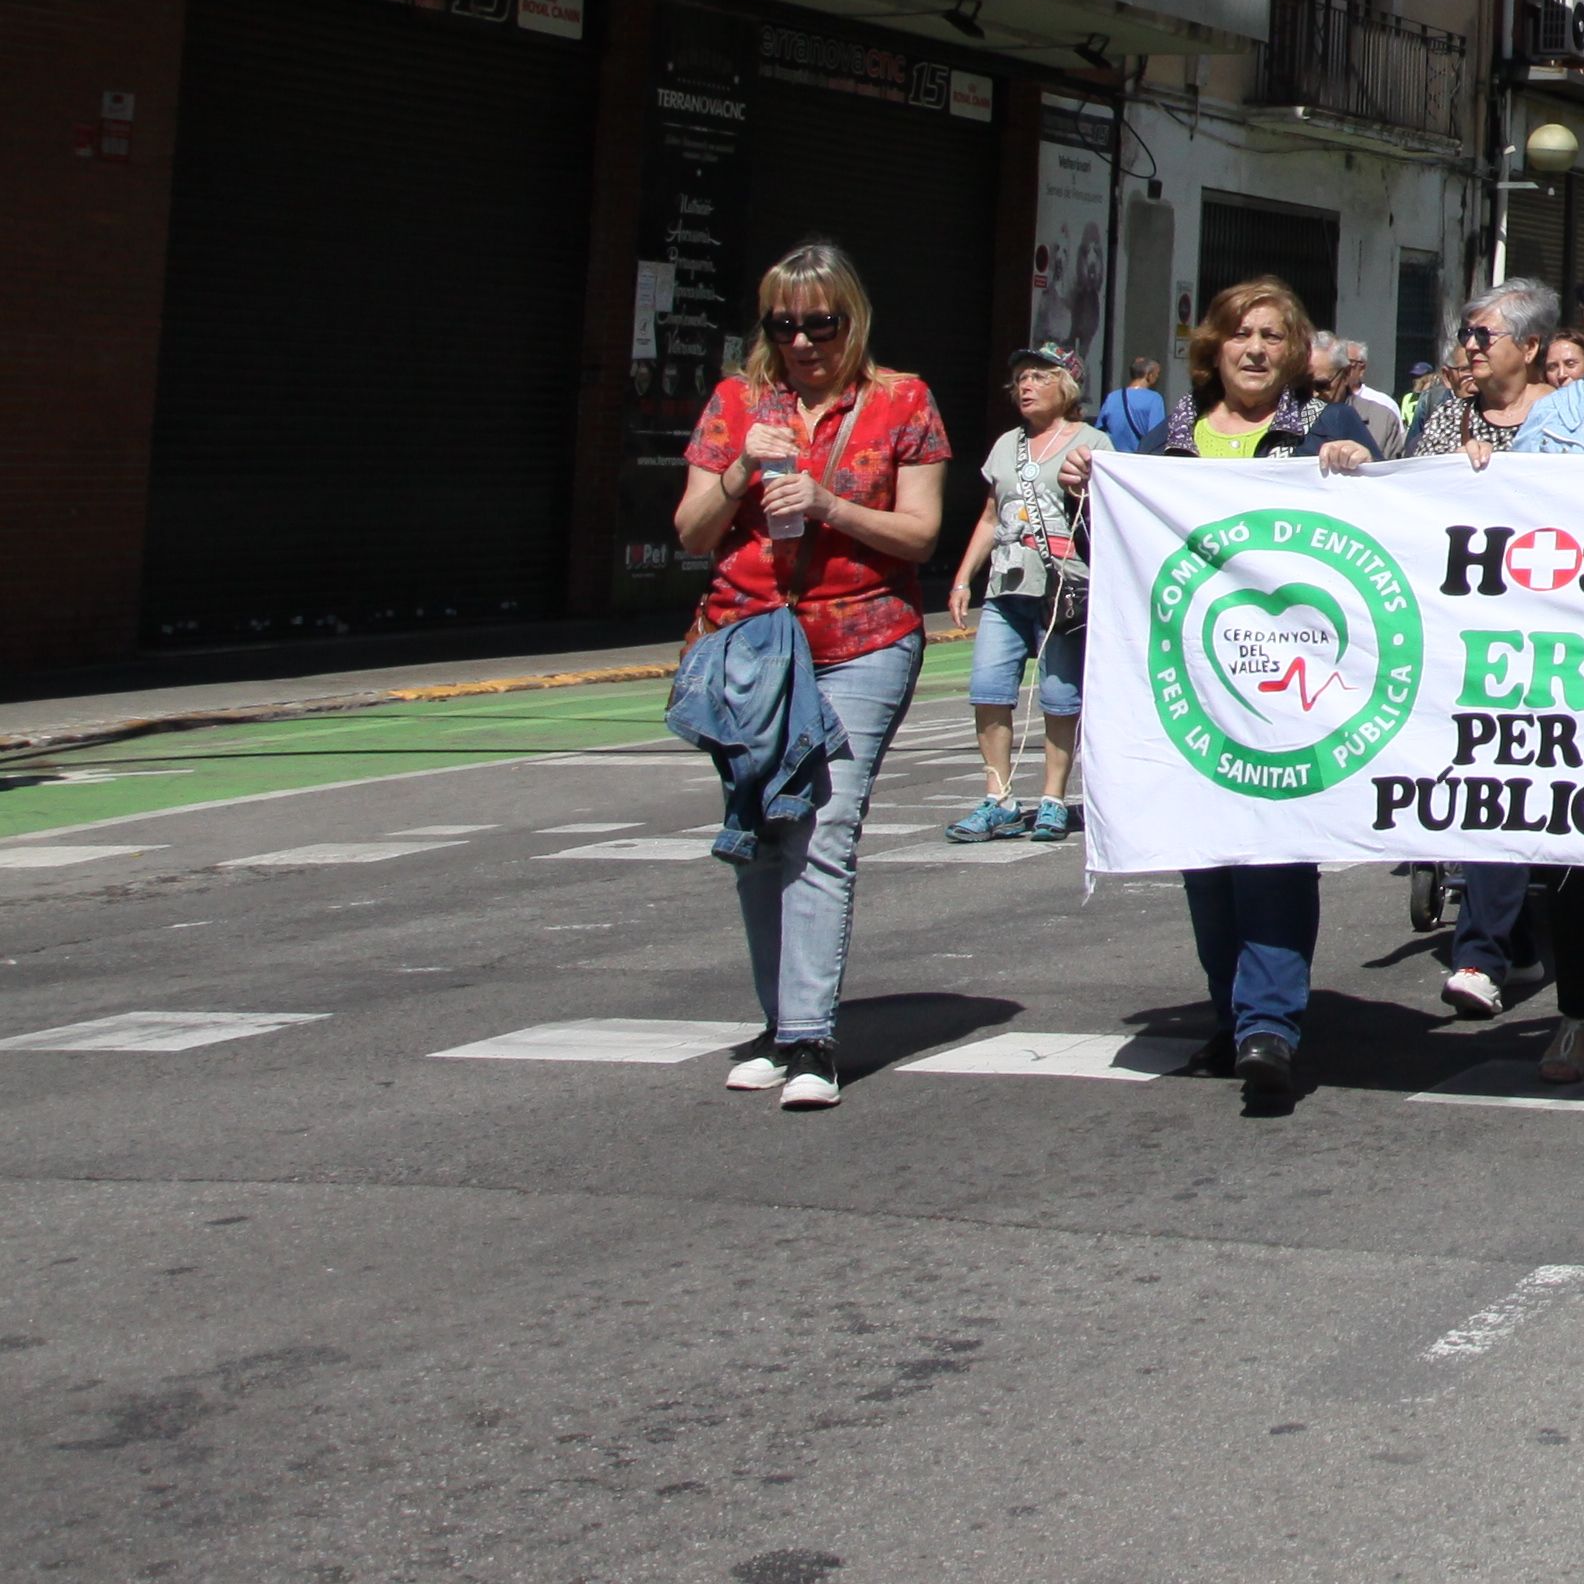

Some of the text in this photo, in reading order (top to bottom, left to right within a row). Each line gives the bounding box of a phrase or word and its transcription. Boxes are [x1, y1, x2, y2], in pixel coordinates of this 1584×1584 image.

[760, 24, 907, 84] erranovacnc
[657, 87, 747, 121] TERRANOVACNC
[1156, 521, 1251, 623] COMISSIÓ
[1310, 526, 1407, 613] ENTITATS
[1223, 627, 1330, 645] CERDANYOLA
[1239, 644, 1269, 659] DEL
[1157, 663, 1413, 793] PER LA SANITAT PÚBLICA
[1452, 714, 1582, 767] PER
